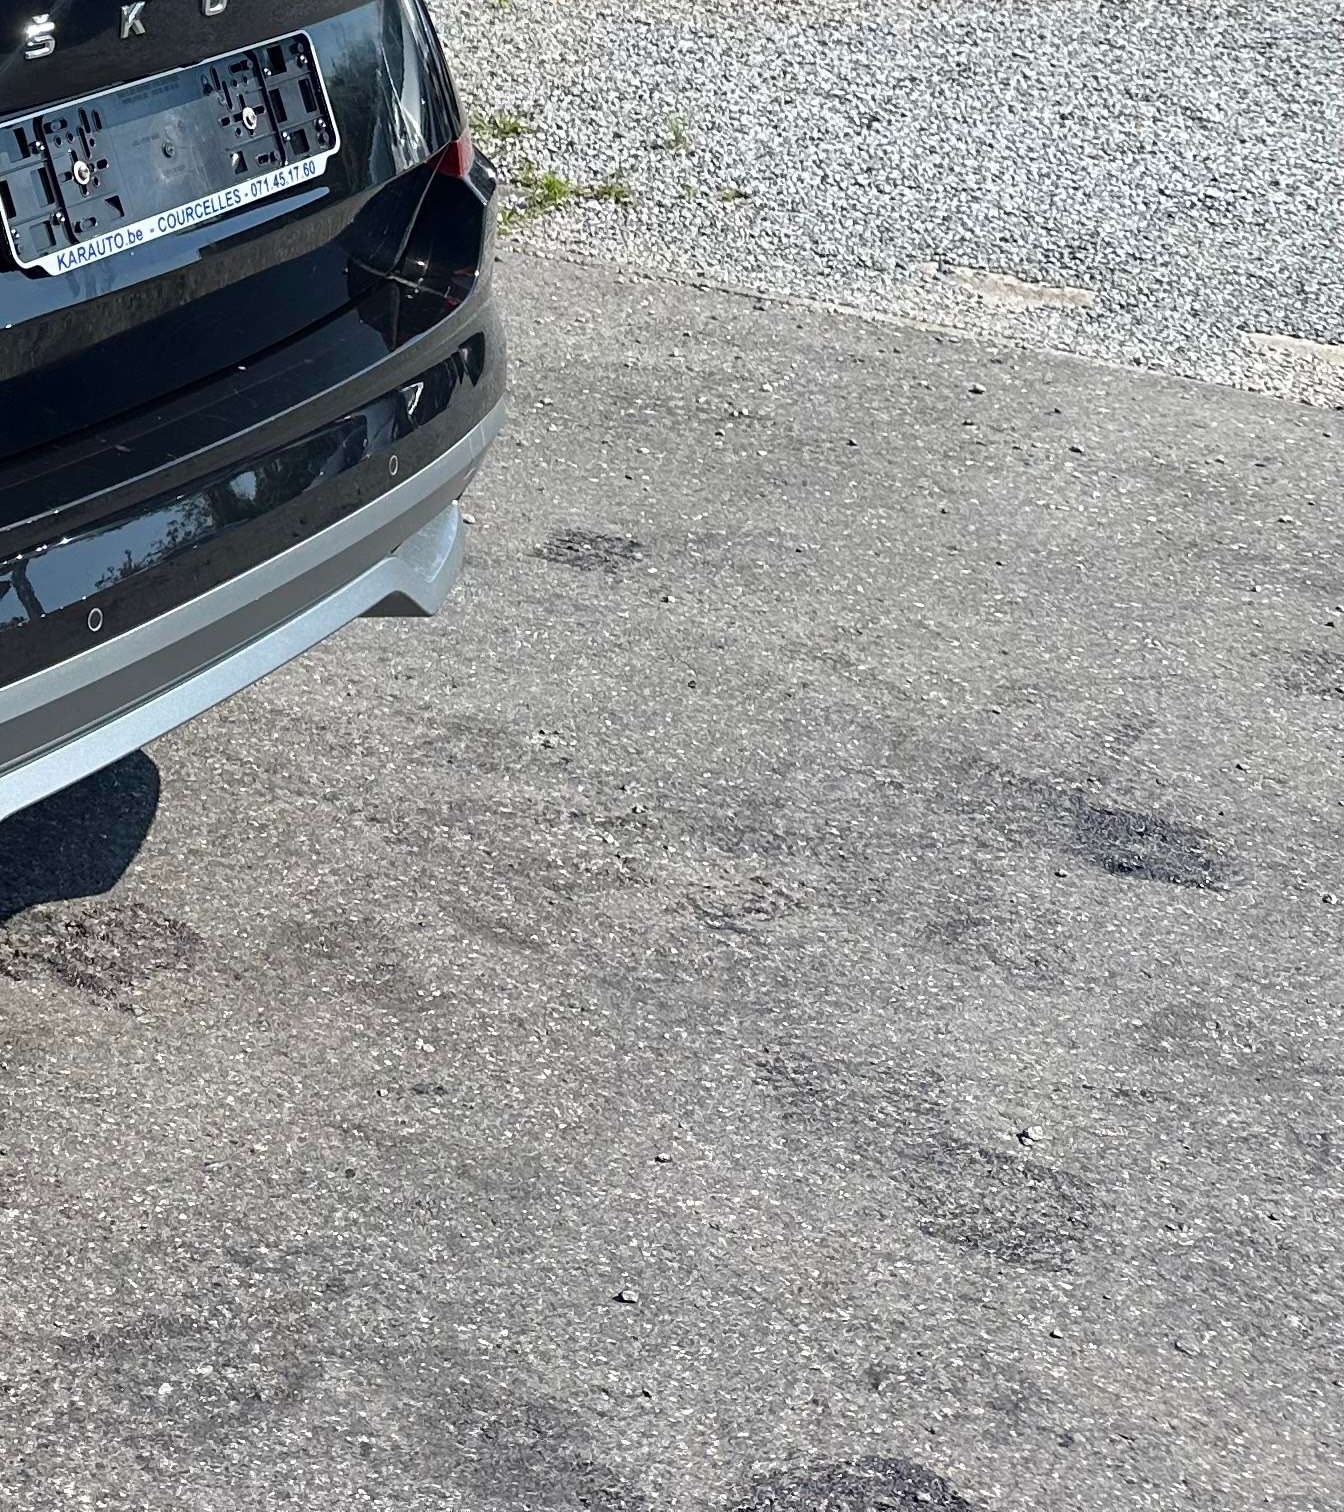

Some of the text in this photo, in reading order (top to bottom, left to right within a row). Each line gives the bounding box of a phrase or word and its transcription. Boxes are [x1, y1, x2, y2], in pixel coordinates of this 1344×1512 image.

[56, 229, 144, 271] KARAUTO.be
[157, 188, 242, 233] COURCELLES
[250, 160, 317, 198] 071.45.17.60
